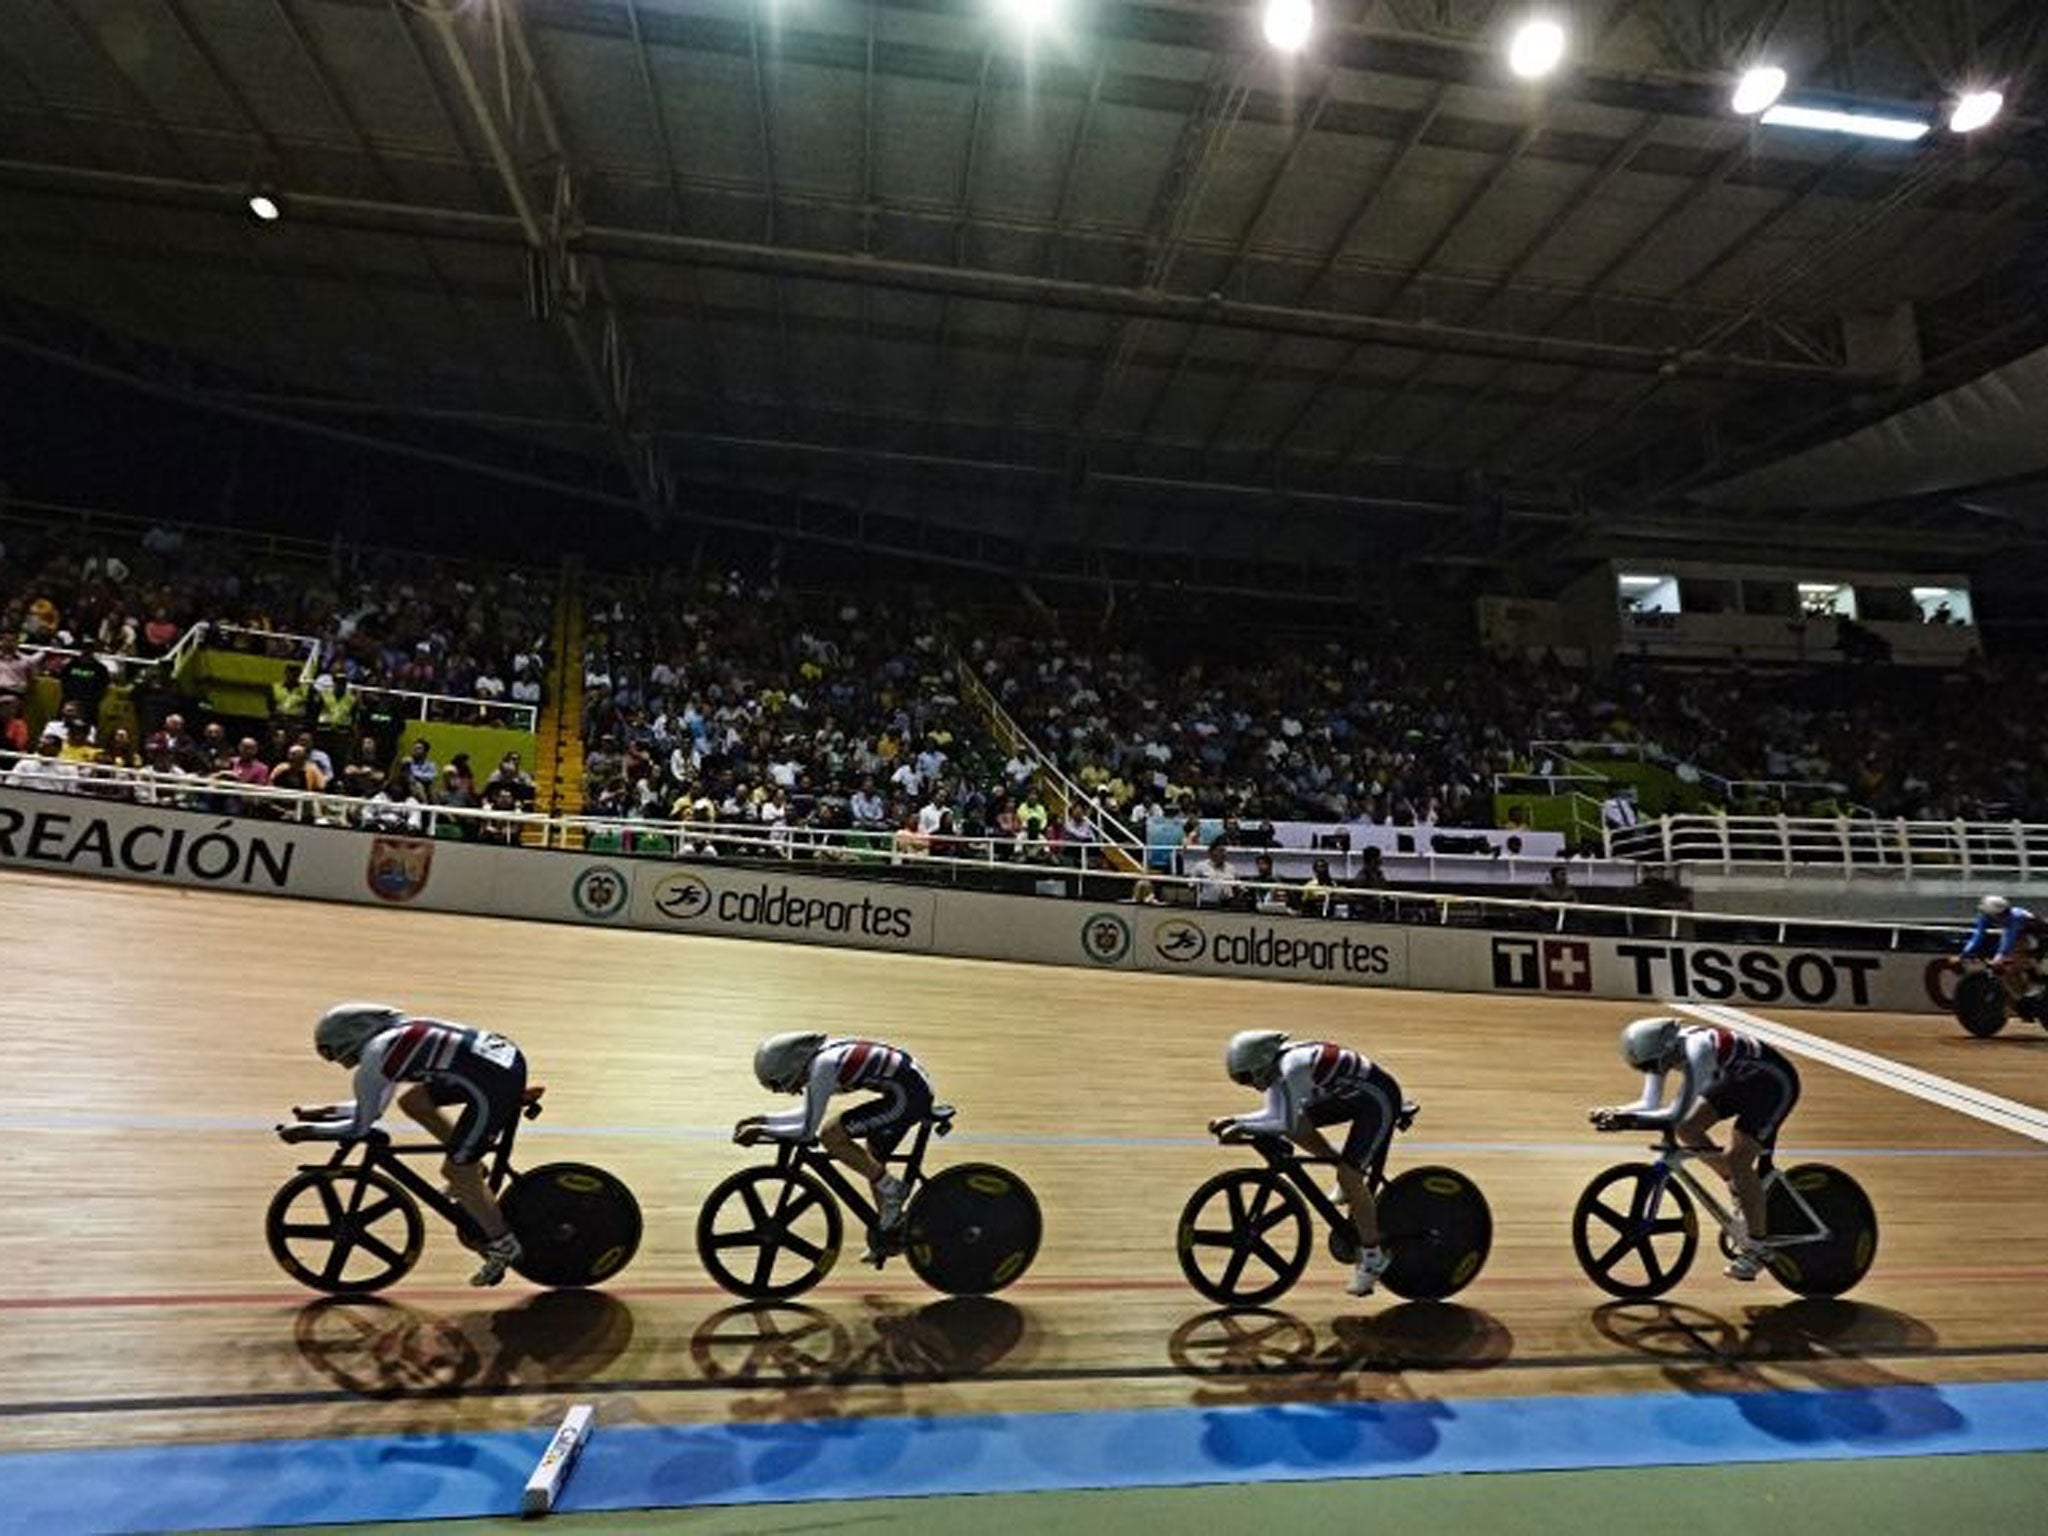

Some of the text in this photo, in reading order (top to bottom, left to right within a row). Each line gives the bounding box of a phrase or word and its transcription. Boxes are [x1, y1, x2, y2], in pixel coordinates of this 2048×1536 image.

[718, 883, 913, 939] coldeportes
[1212, 926, 1390, 975] coldeportes
[1615, 944, 1881, 1006] TISSOT
